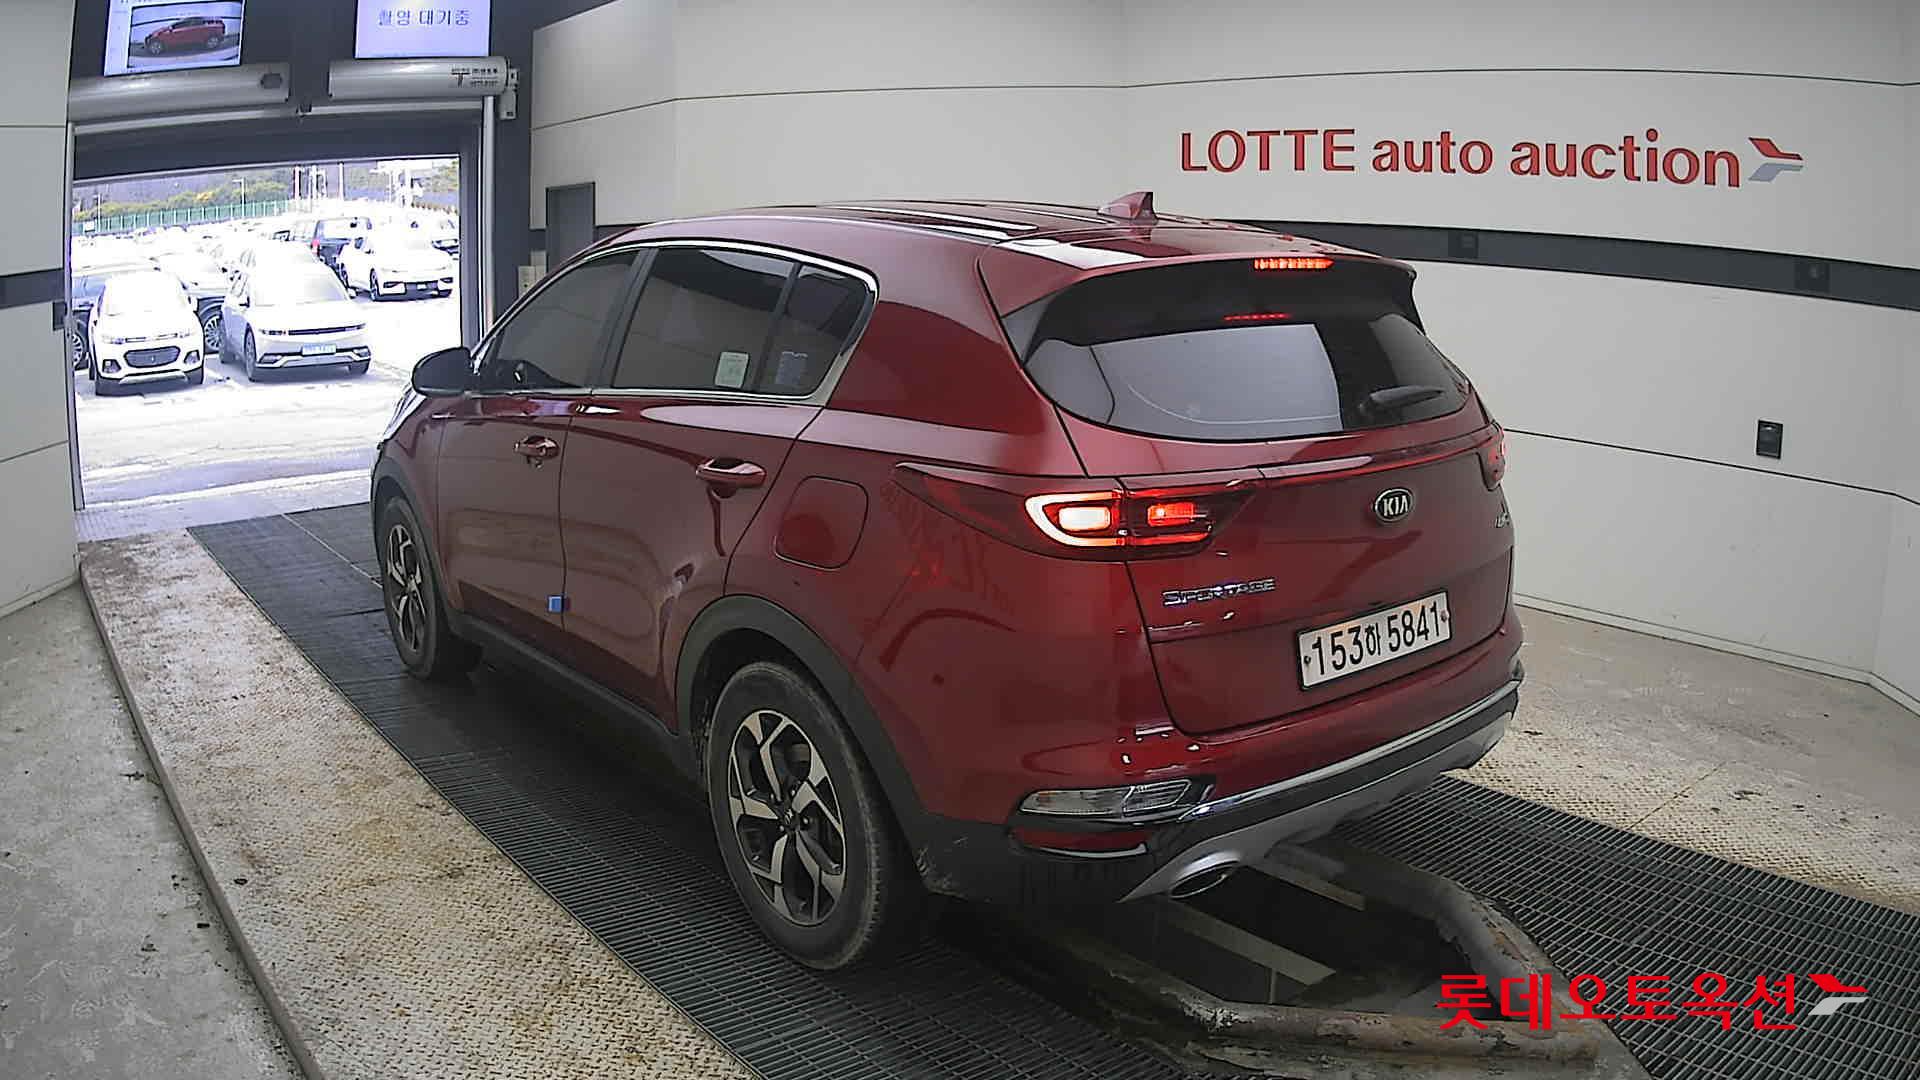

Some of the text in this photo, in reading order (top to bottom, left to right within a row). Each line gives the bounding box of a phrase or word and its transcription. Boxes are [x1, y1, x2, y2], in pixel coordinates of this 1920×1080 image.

[419, 9, 471, 26] 대기중
[1181, 128, 1740, 188] LOTTE auto auction
[1382, 494, 1409, 517] KIA
